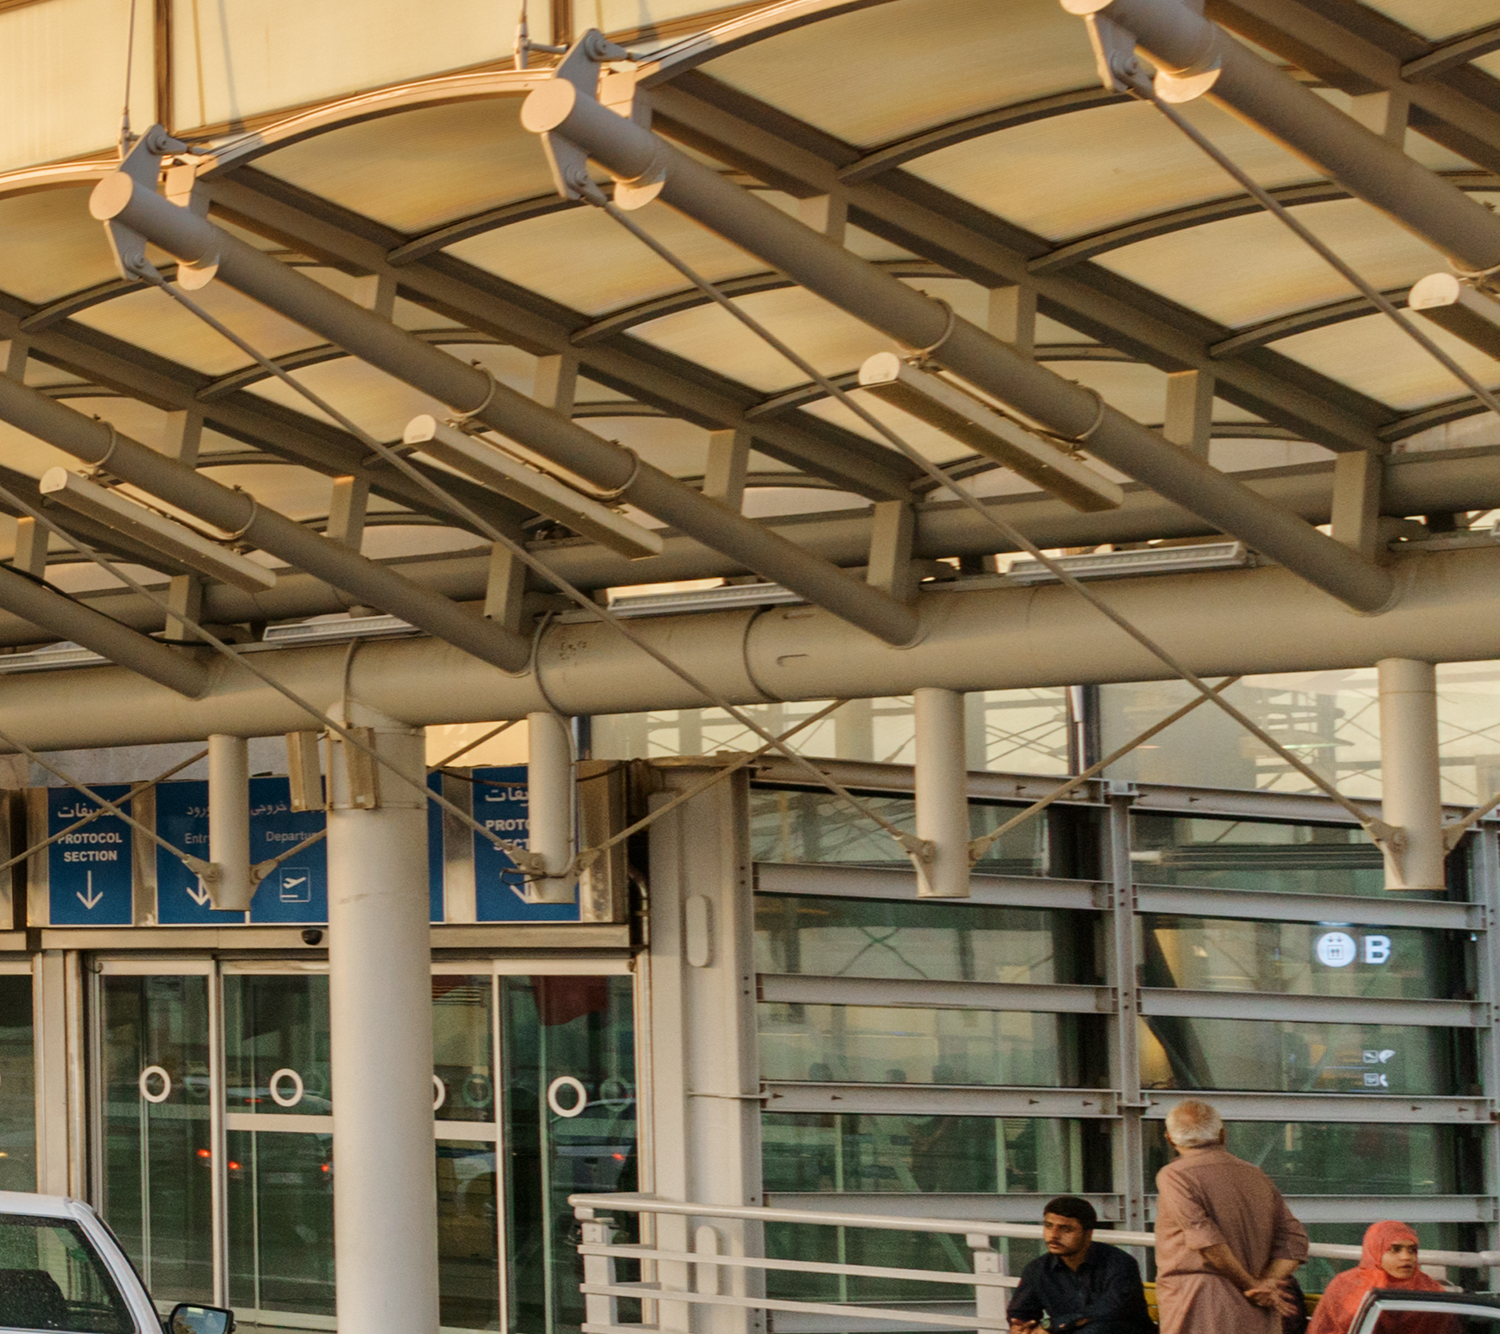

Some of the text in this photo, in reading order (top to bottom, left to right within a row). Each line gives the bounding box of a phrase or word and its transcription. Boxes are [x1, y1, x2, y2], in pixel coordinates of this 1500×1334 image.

[485, 786, 529, 807] یفات
[485, 819, 529, 831] PROT
[185, 833, 209, 844] Entr
[266, 831, 318, 842] Departu
[64, 850, 117, 862] SECTION
[1364, 934, 1391, 964] B
